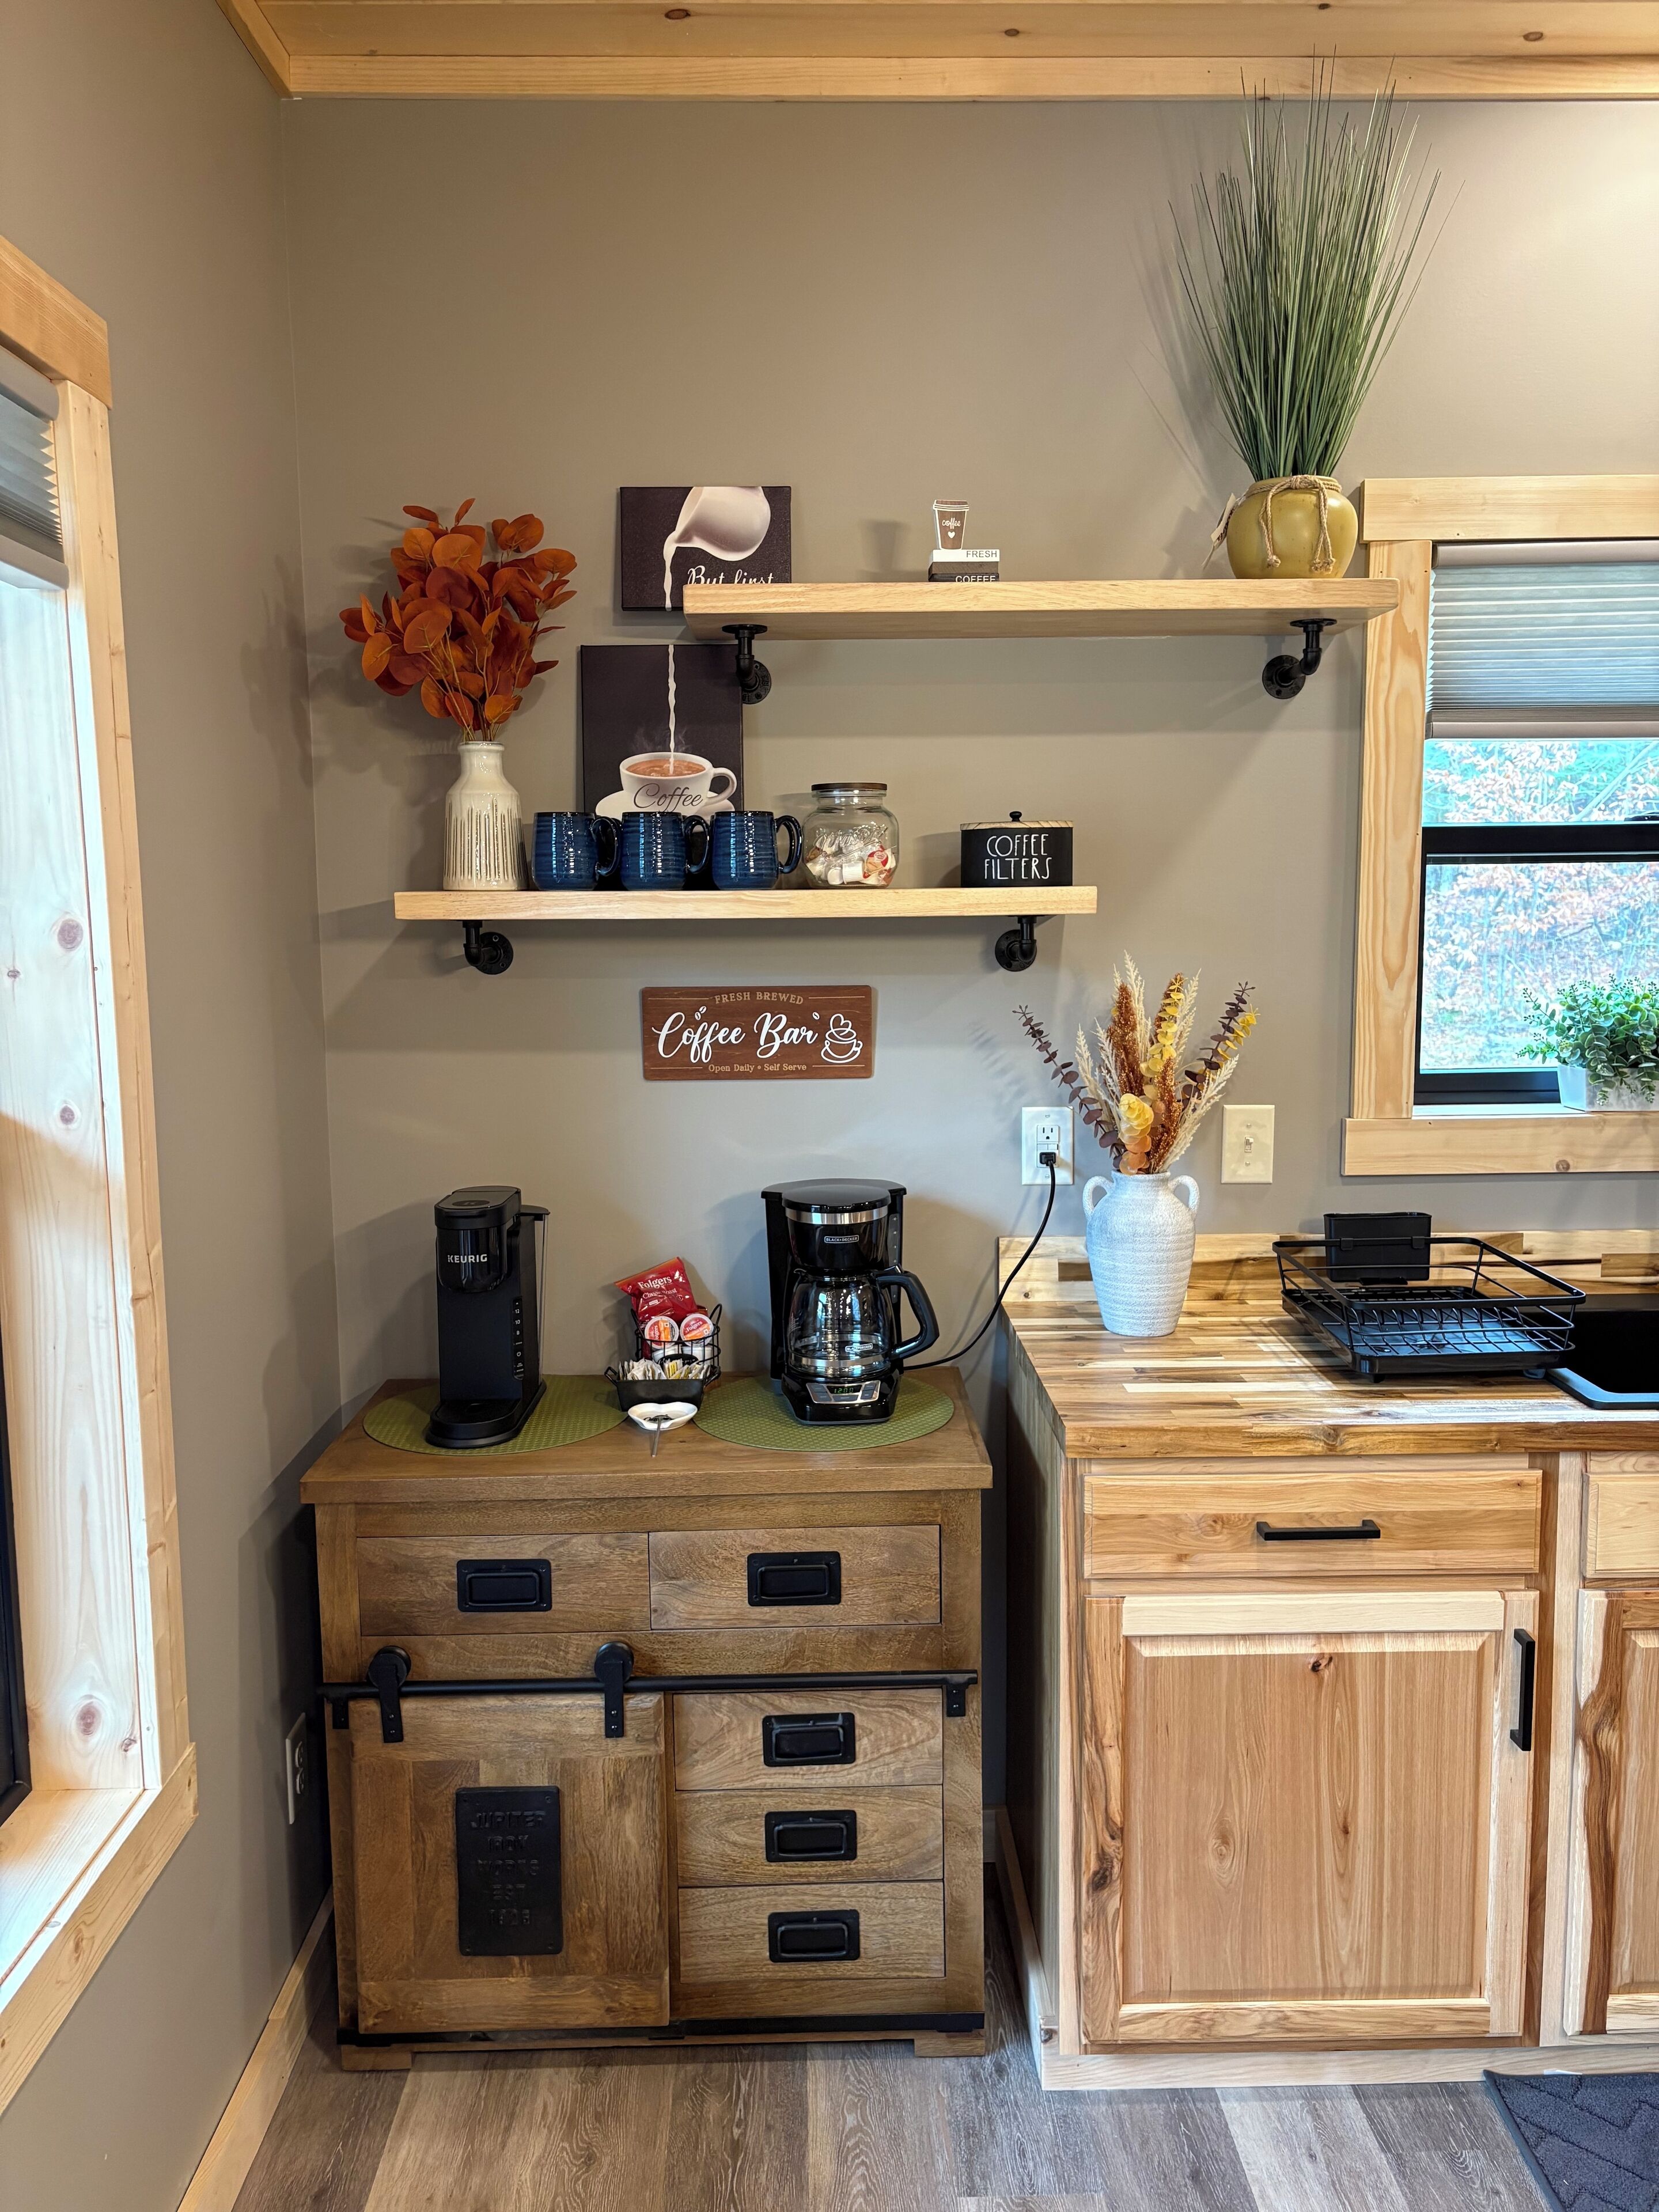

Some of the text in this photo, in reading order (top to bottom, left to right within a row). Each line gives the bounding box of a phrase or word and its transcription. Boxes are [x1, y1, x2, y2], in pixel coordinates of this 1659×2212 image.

[942, 517, 961, 529] coffee
[966, 550, 998, 558] FRESH
[687, 565, 725, 585] But
[634, 783, 703, 813] Coffee
[986, 834, 1049, 857] COFFEE
[984, 857, 1052, 880] FILTERS
[714, 991, 804, 1005] FRESH BREWED
[652, 1012, 819, 1063] Coffee Bar
[708, 1064, 731, 1073] Open
[733, 1063, 755, 1073] Daily
[763, 1063, 781, 1071] Self
[447, 1253, 488, 1263] KEURIG
[638, 1276, 672, 1289] Folgers
